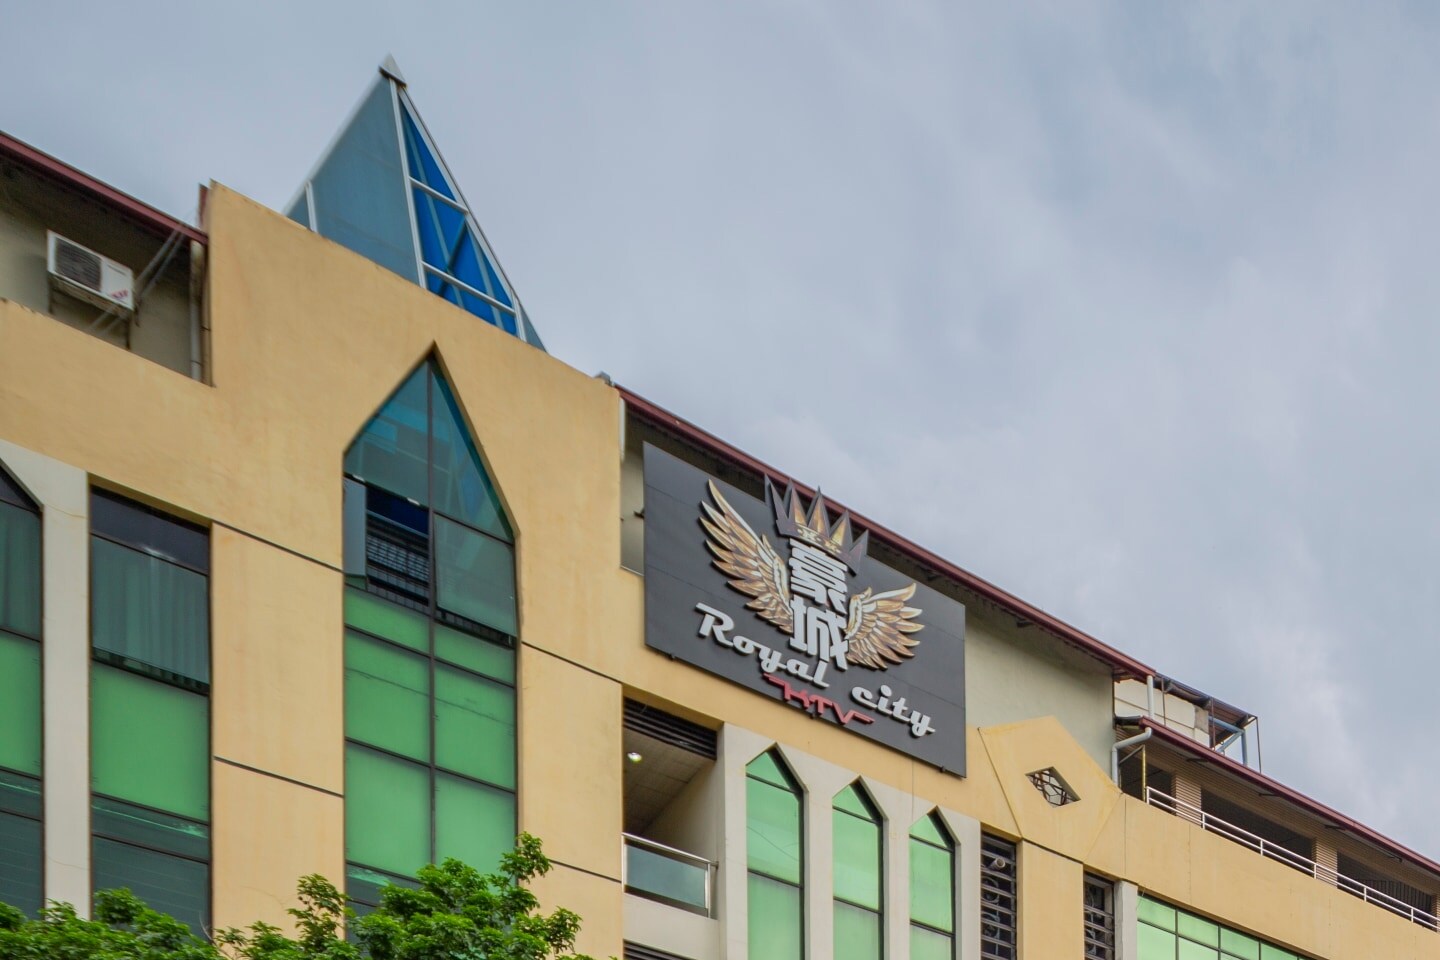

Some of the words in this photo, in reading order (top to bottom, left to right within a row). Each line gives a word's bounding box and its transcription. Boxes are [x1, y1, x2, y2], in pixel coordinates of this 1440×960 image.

[695, 602, 830, 688] Royal
[851, 684, 936, 737] city
[762, 672, 876, 725] KTV
